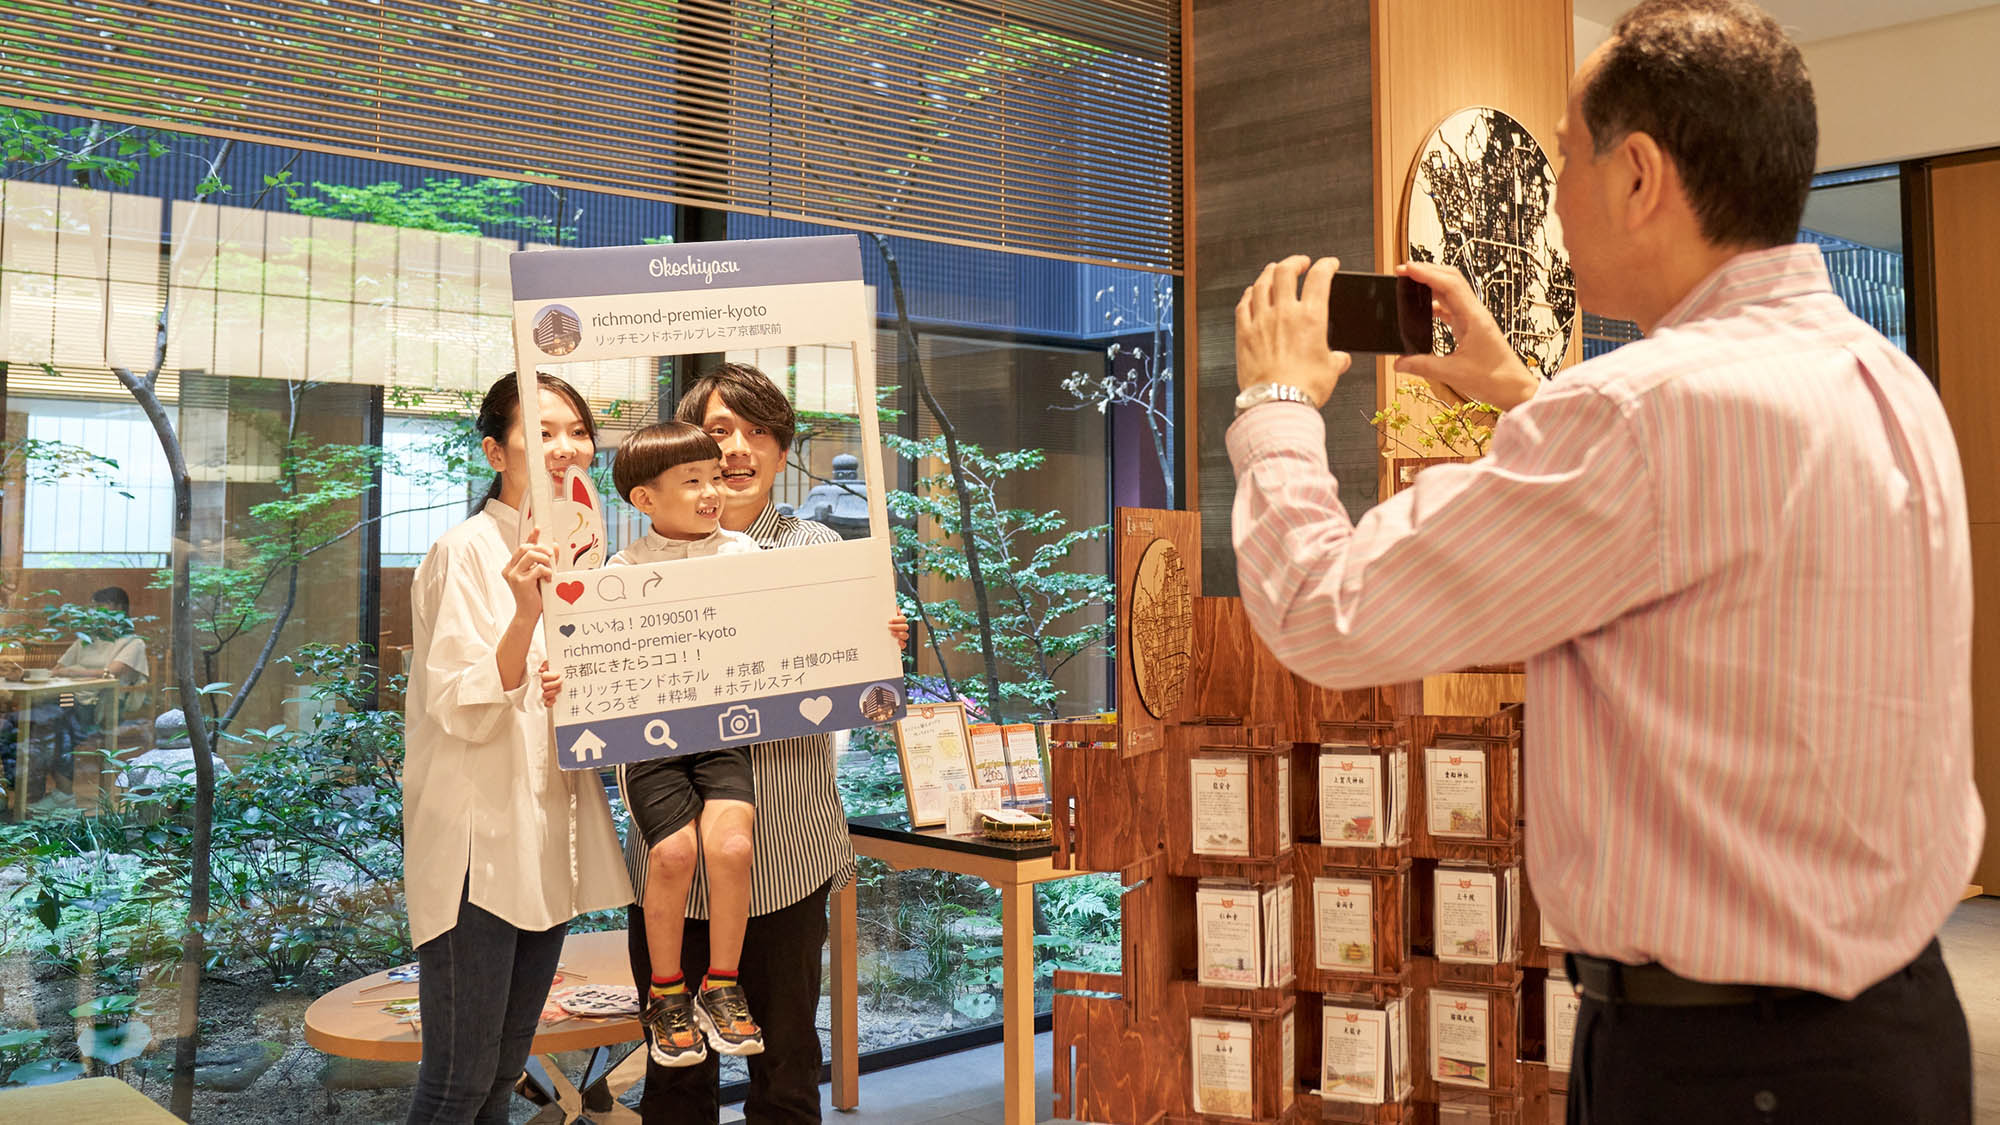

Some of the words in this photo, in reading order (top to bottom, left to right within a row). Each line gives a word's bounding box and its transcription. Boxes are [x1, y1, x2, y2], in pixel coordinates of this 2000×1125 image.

[649, 255, 741, 285] Okoshiyasu
[592, 304, 768, 328] richmond-premier-kyoto
[595, 322, 782, 347] リッチモンドホテルプレミア京都駅前
[563, 625, 737, 658] richmond-premier-kyoto
[563, 649, 702, 680] 京都にきたらココ！！
